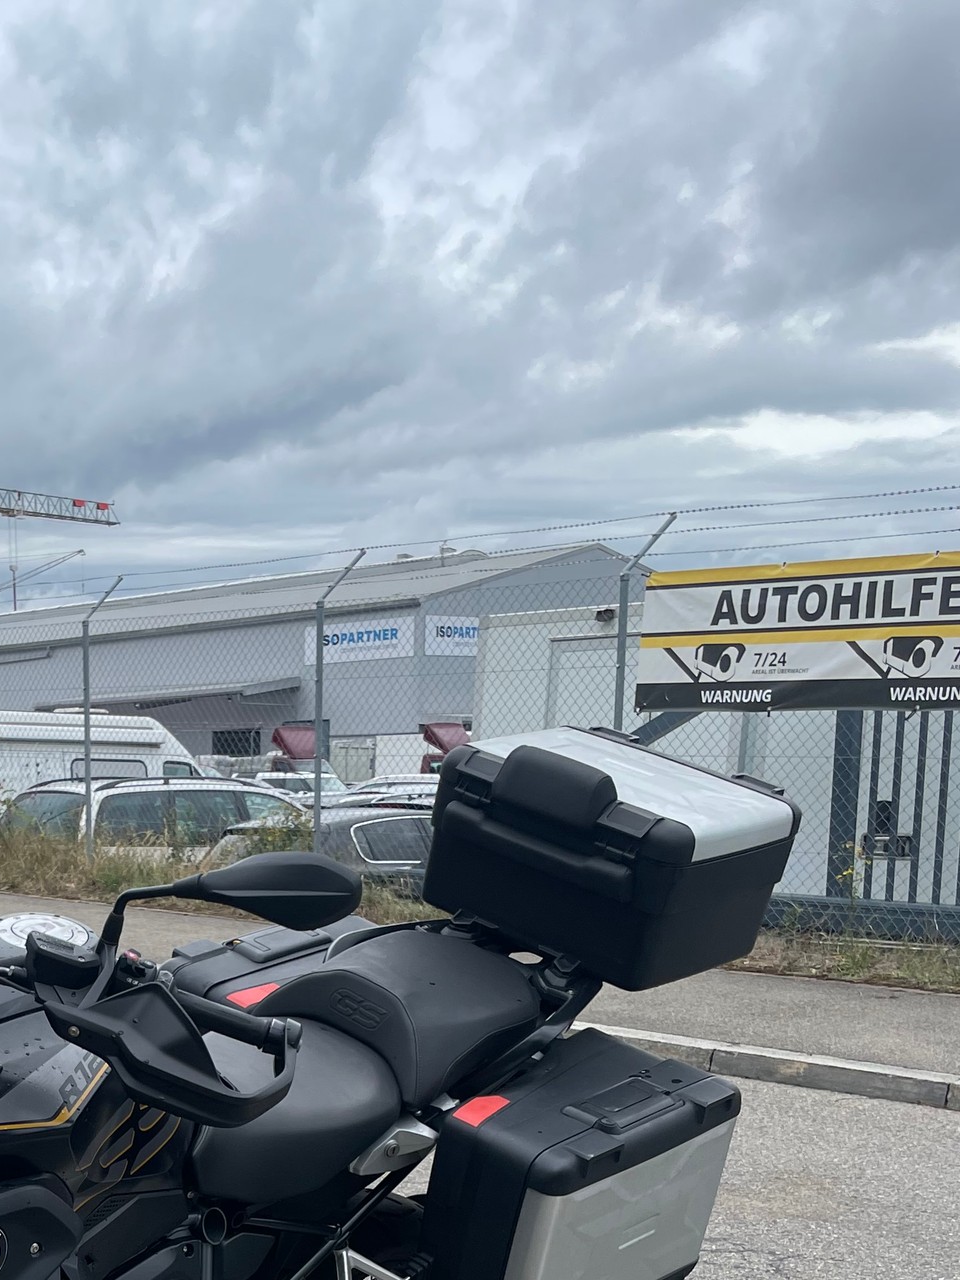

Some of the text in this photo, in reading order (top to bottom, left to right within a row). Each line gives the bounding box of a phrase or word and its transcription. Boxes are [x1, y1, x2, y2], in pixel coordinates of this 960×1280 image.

[710, 576, 960, 626] AUTOHILFE
[322, 628, 399, 646] SOPARTNER
[436, 625, 479, 638] ISOPART
[753, 652, 787, 668] 7/24
[777, 667, 809, 675] ÜBERWACHT
[700, 689, 772, 703] WARNUNG
